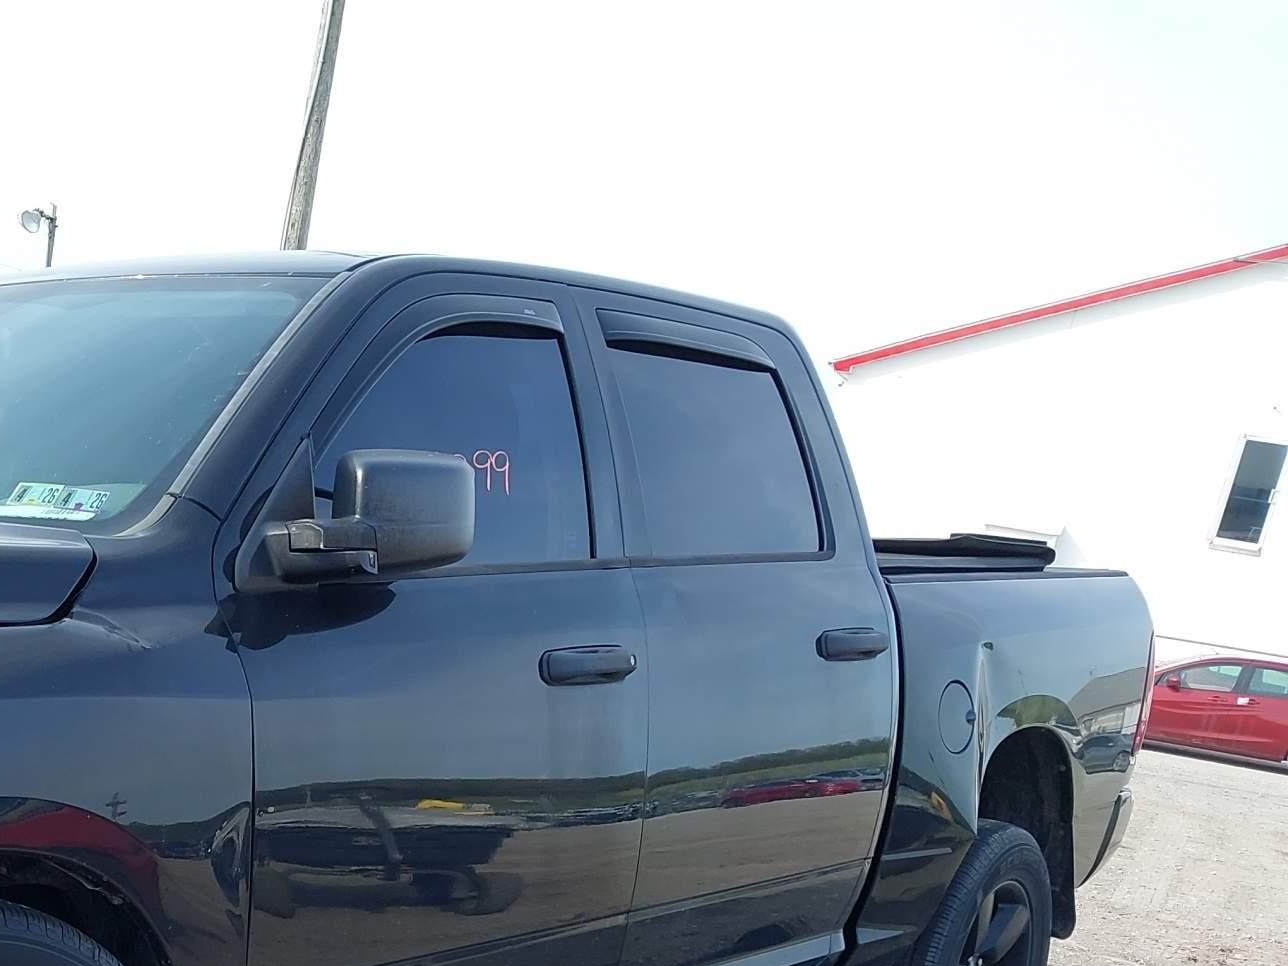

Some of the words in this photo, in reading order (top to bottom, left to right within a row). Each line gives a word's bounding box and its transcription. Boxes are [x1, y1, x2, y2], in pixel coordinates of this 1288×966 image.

[454, 450, 511, 497] 99
[42, 487, 60, 504] 26
[89, 492, 108, 510] 26
